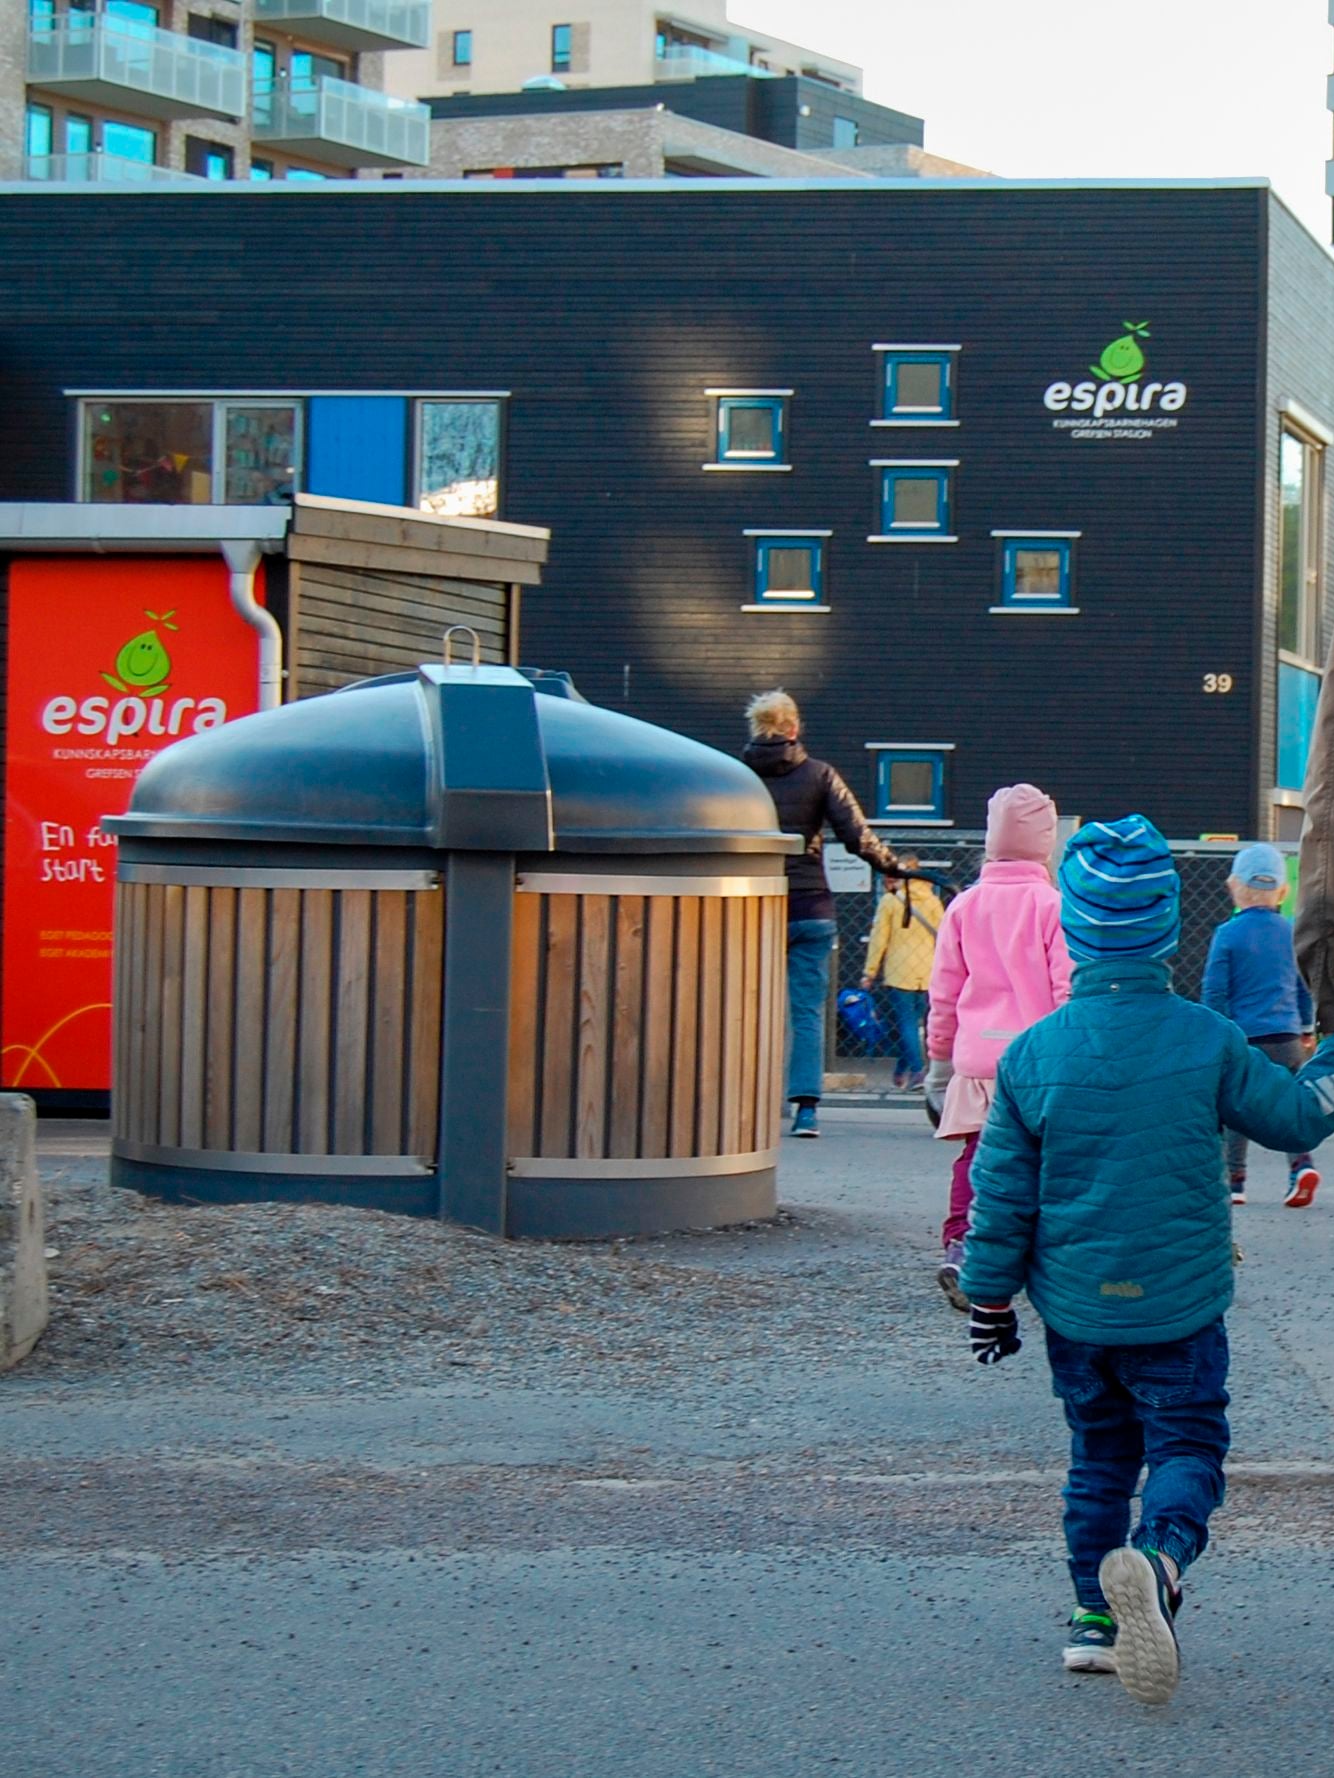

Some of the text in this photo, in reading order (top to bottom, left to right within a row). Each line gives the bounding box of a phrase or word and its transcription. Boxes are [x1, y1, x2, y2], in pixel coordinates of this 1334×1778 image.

[1043, 381, 1187, 418] espira
[1203, 673, 1233, 693] 39
[42, 696, 227, 746] espira
[41, 821, 75, 851] En
